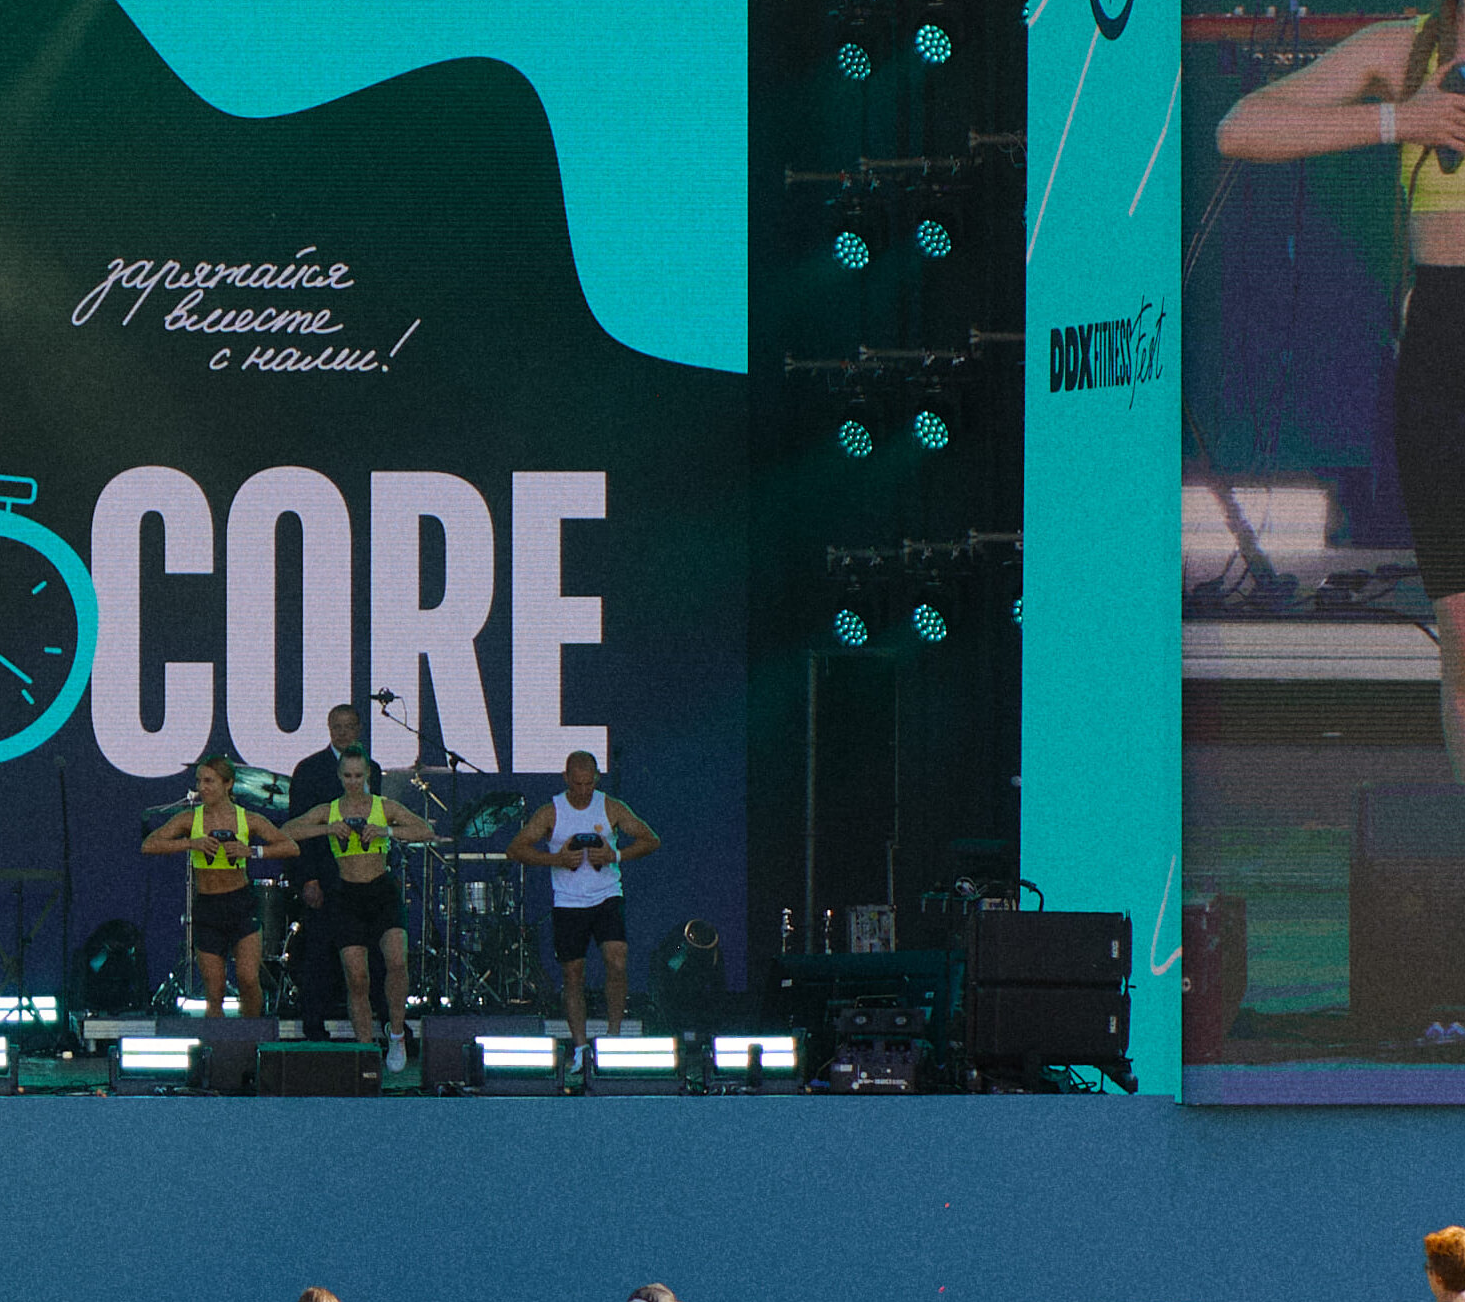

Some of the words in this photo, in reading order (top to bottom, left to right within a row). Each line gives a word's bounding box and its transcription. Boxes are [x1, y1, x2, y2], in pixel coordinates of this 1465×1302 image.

[71, 245, 356, 327] заряжайся
[165, 288, 345, 334] вместе
[209, 347, 232, 371] с
[240, 317, 422, 374] нами!
[1049, 323, 1093, 393] DDX
[90, 465, 609, 779] CORE
